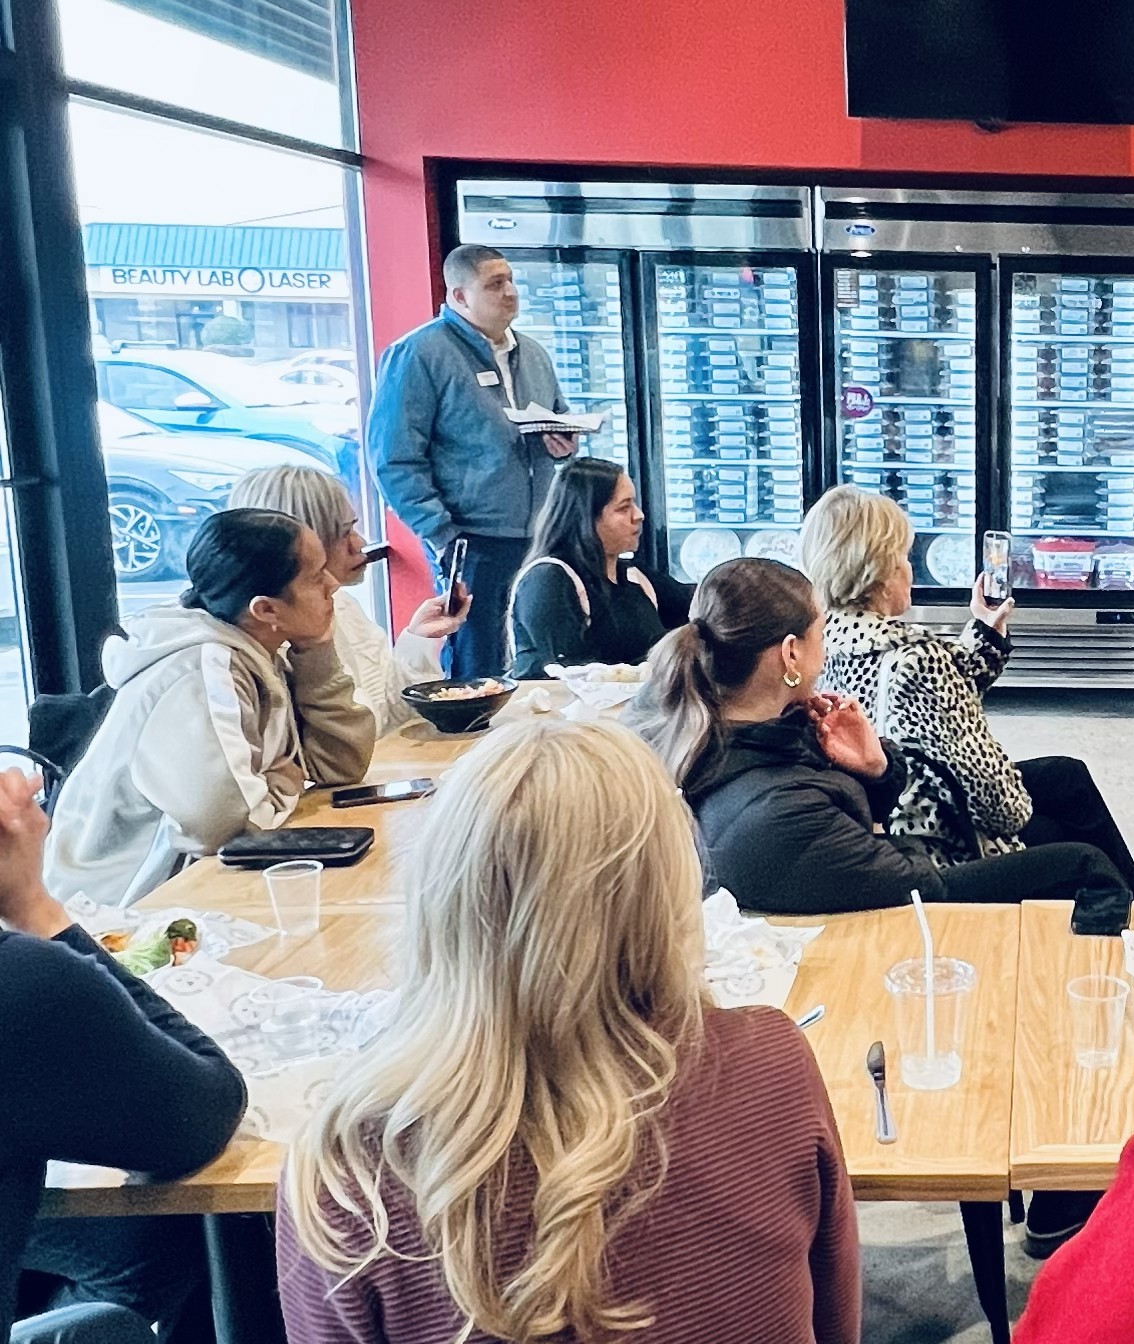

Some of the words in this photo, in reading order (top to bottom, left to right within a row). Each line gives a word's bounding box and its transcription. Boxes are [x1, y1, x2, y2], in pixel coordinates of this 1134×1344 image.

[112, 268, 193, 285] BEAUTY
[198, 270, 233, 286] LAB
[269, 272, 331, 289] LASER
